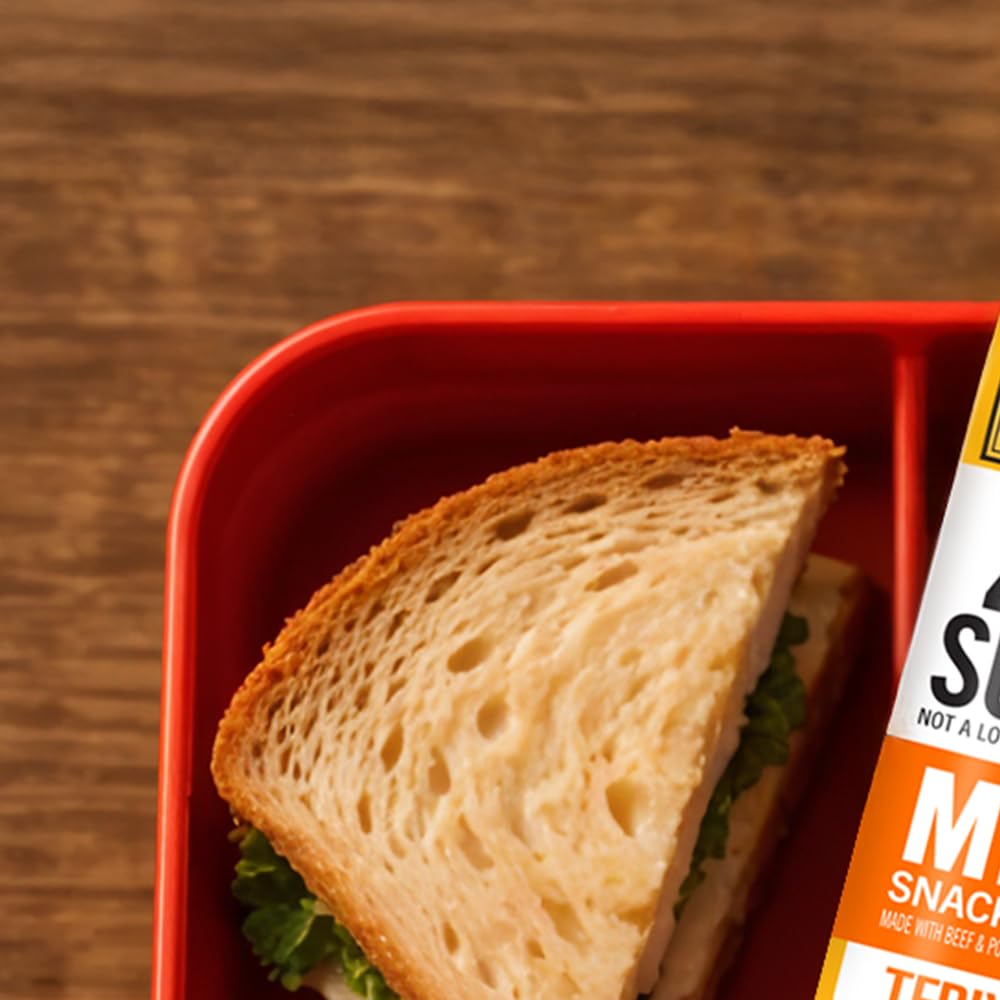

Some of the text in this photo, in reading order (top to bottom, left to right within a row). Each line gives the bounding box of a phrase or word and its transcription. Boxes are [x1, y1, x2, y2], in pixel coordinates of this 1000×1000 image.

[917, 707, 956, 733] NOT
[958, 715, 971, 737] A
[879, 909, 912, 935] MADE
[915, 918, 944, 943] WITH
[944, 925, 976, 949] BEEF
[974, 935, 985, 953] &
